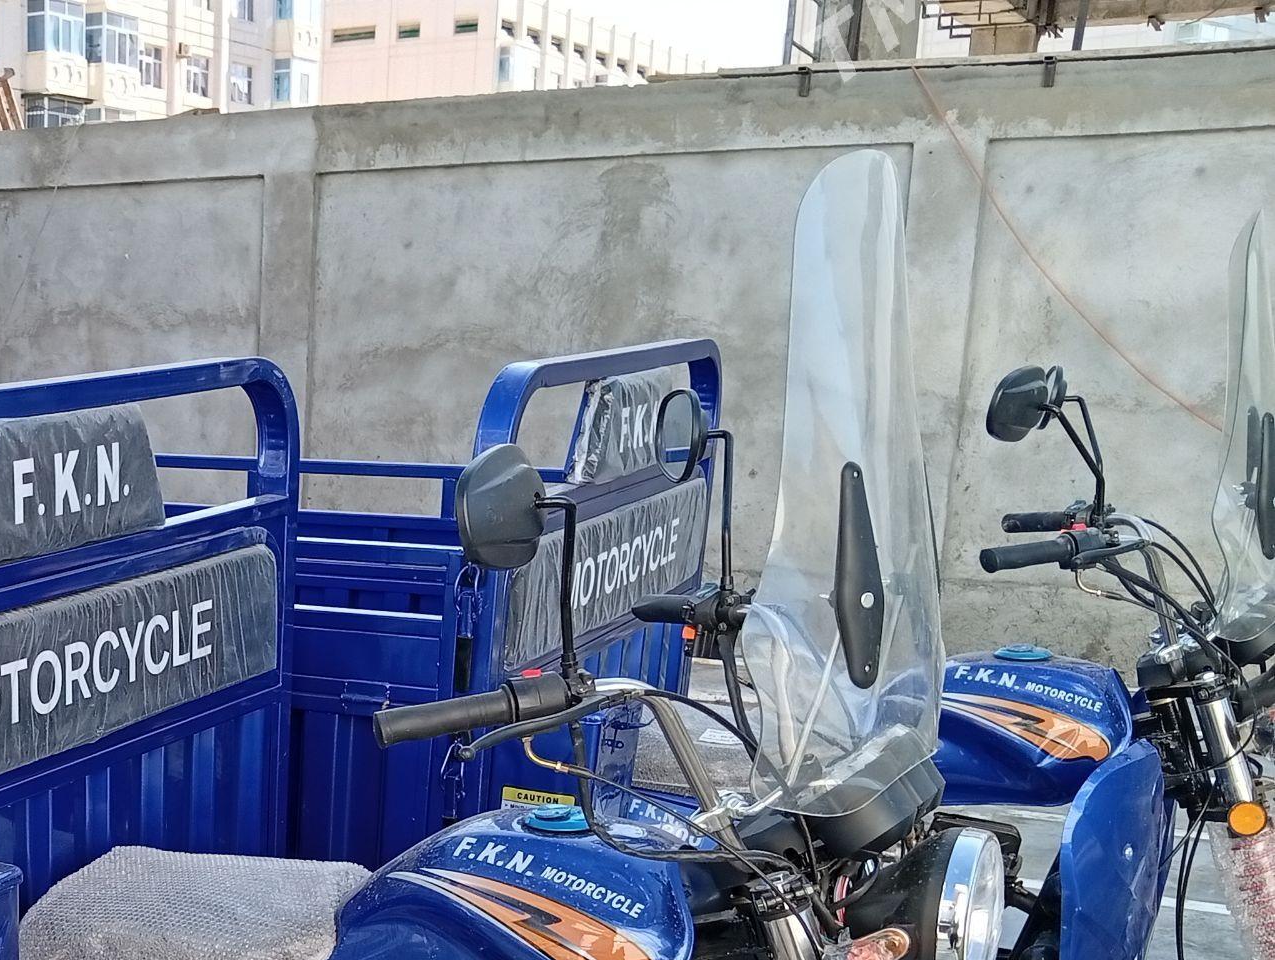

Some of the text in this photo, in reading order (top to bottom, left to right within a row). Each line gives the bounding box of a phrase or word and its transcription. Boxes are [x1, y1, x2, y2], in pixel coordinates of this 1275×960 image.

[13, 442, 130, 525] F.K.N.
[954, 665, 1103, 713] F.K.N. MOTORCYCLE
[517, 792, 559, 804] CAUTION
[453, 836, 645, 920] F.K.N. MOTORCYCLE
